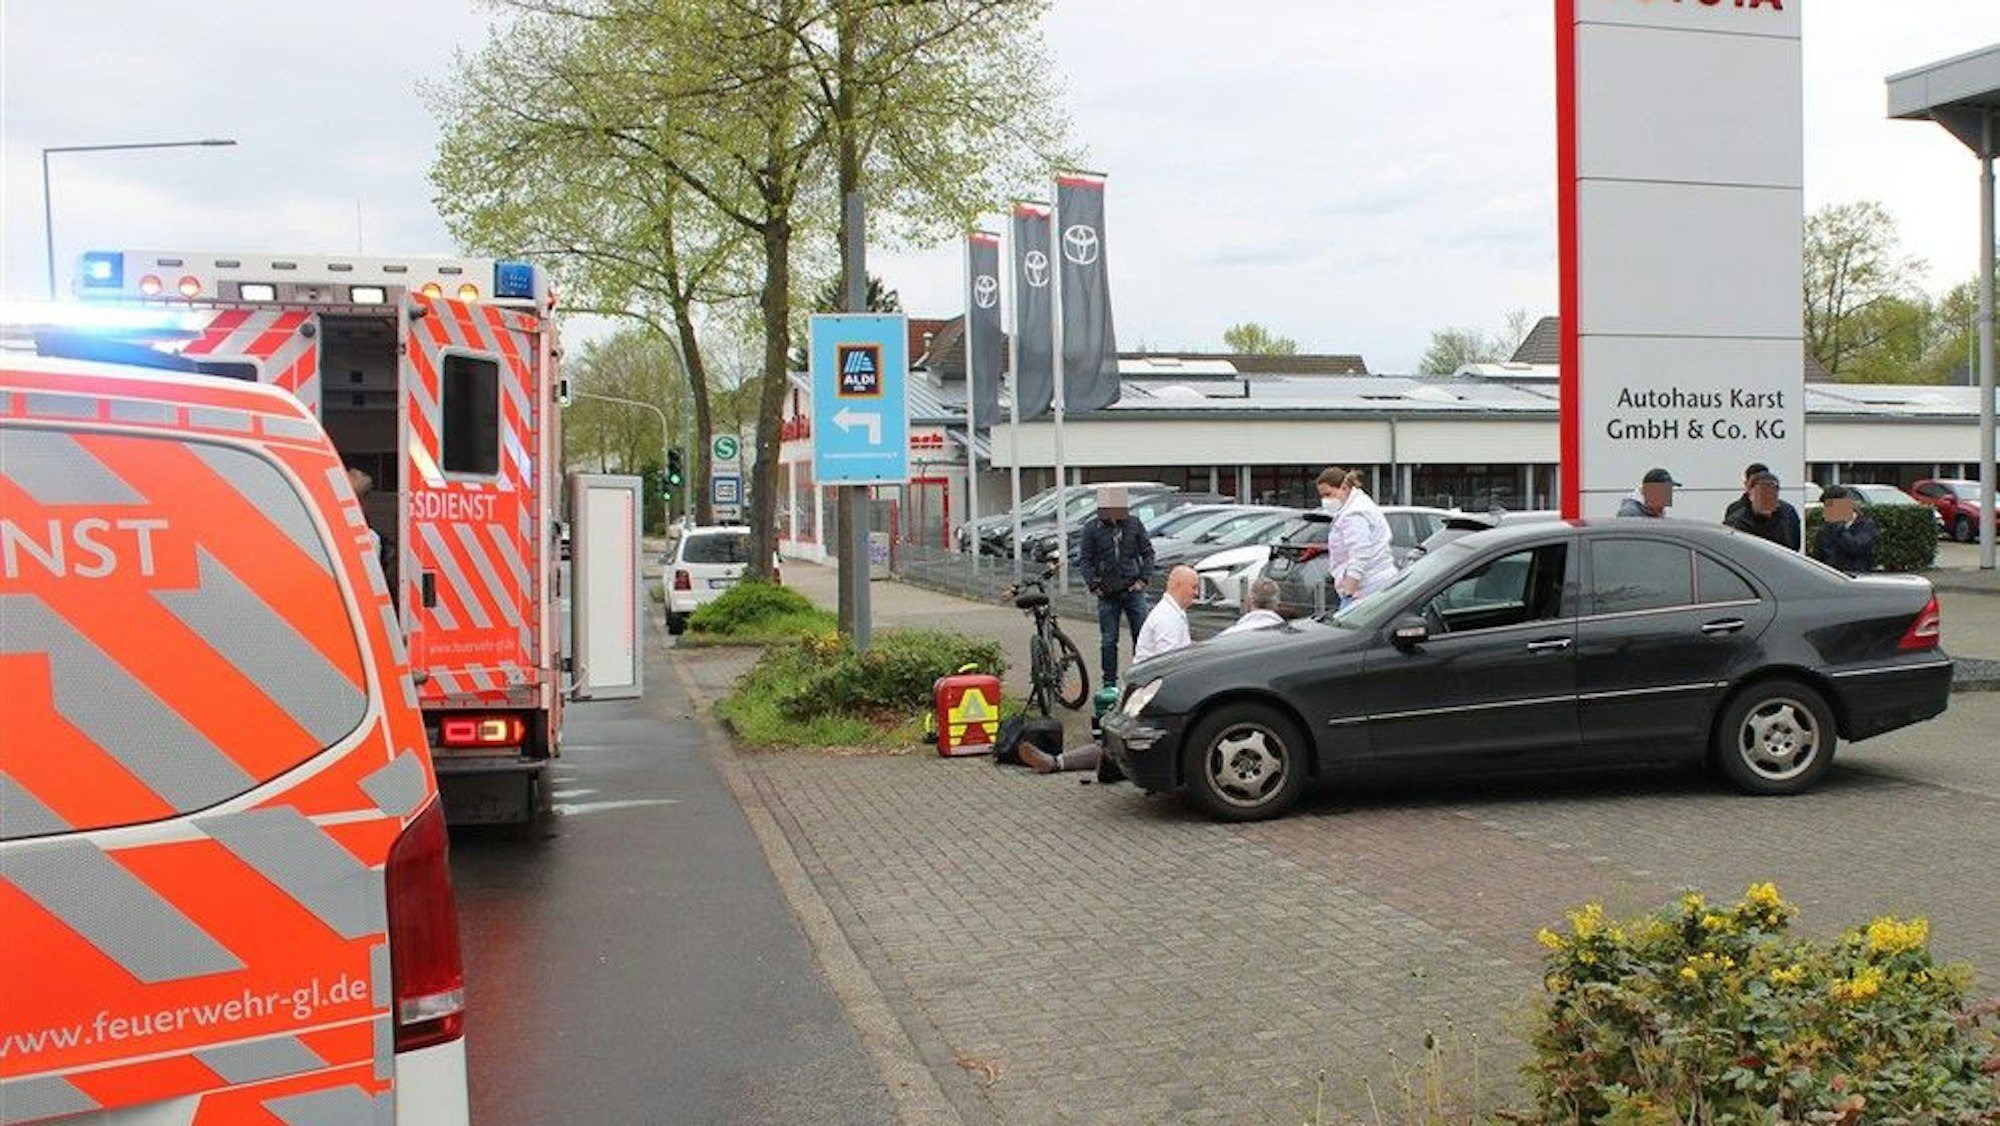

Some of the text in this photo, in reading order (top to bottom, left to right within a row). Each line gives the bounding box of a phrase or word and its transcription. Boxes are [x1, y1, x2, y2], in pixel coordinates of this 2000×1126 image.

[843, 373, 876, 386] ALDI
[1616, 387, 1785, 409] Autohaus Karst
[1606, 418, 1786, 440] GmbH & Co. KG
[717, 438, 736, 458] S
